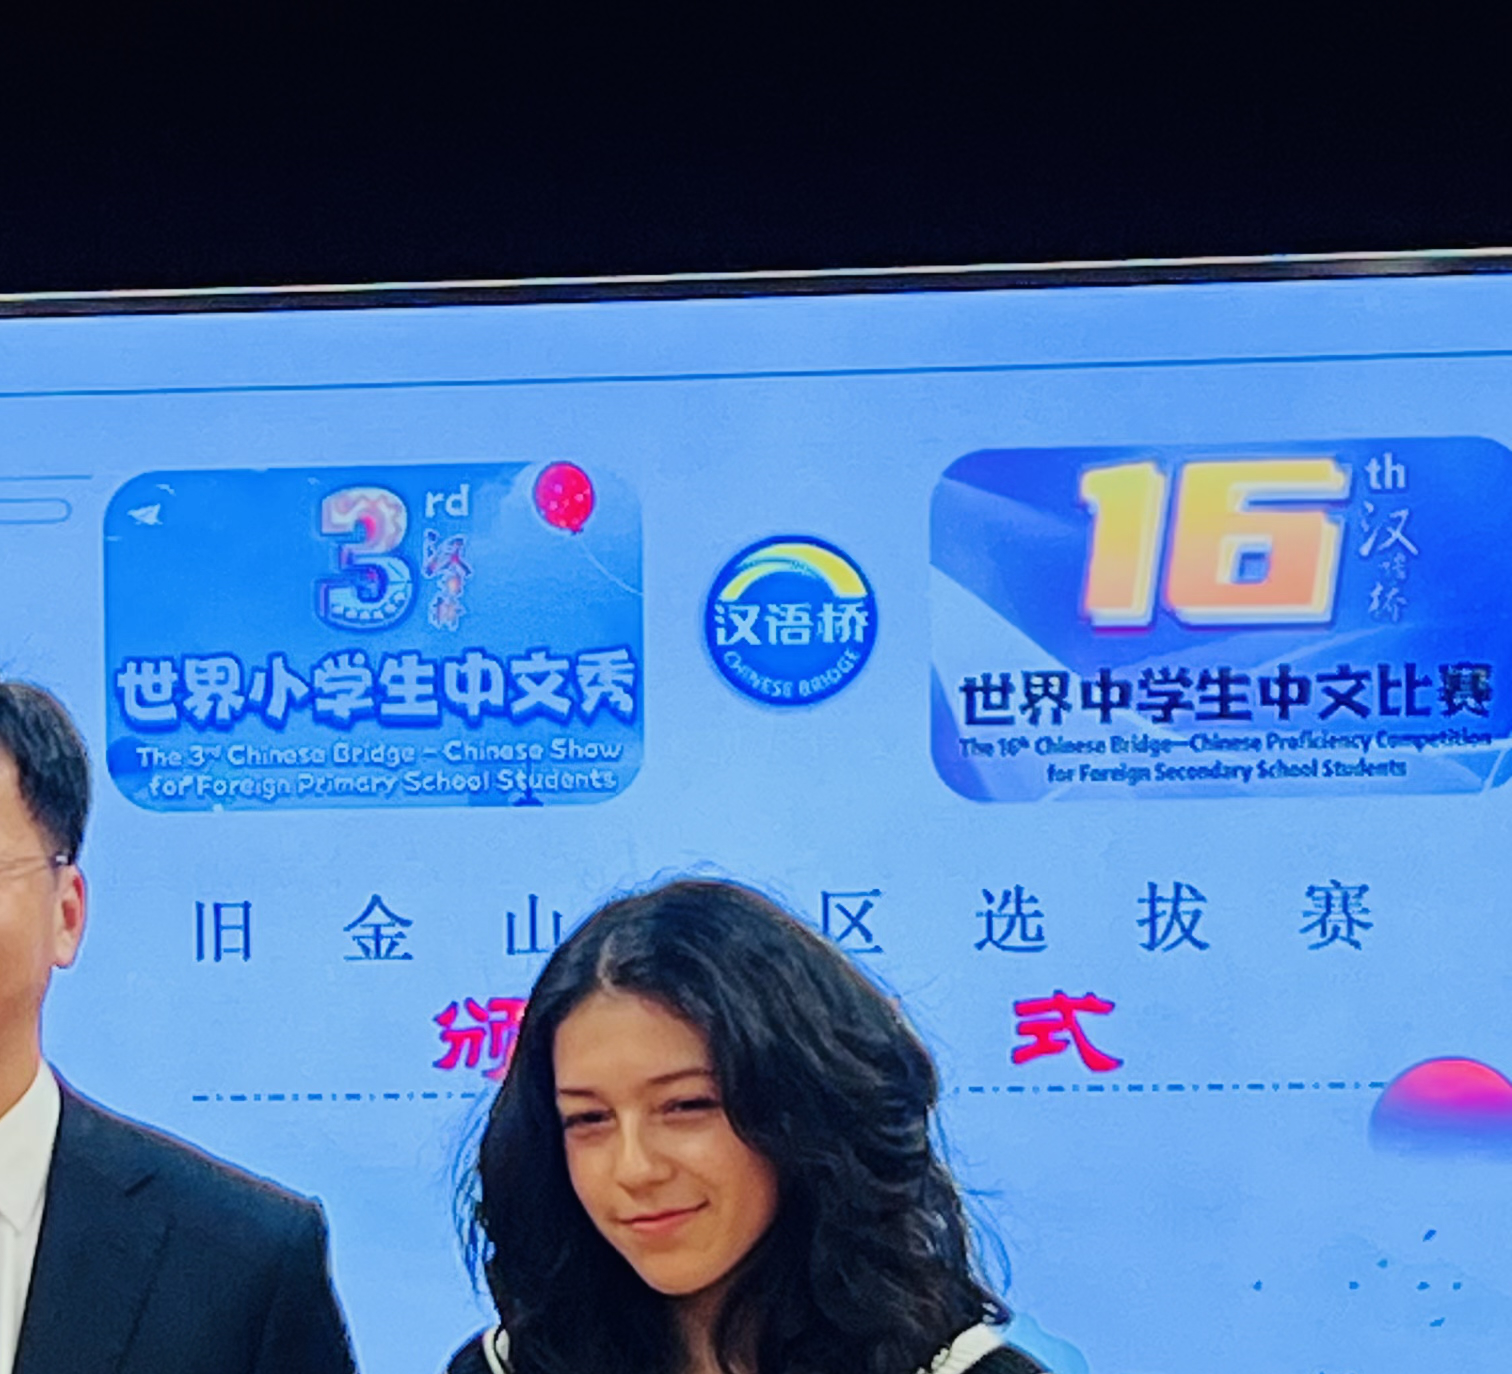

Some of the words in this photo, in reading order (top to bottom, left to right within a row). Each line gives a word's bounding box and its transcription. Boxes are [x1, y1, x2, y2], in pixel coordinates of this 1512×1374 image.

[713, 602, 870, 646] 汉语桥
[116, 647, 636, 723] 世界小学生中文秀
[723, 650, 793, 698] CHINESE
[798, 648, 862, 697] BRIDGE
[958, 661, 1493, 726] 世界中学生中文比赛
[136, 746, 182, 767] The
[226, 743, 325, 766] Chinese
[333, 741, 415, 767] Bridge
[442, 739, 544, 761] Chinese
[550, 737, 623, 760] Show
[959, 737, 994, 757] The
[1034, 735, 1106, 756] Chinese
[1265, 729, 1372, 753] Proficiency
[1376, 726, 1493, 752] Competition
[149, 774, 194, 797] for
[196, 774, 294, 800] Foreign
[297, 772, 399, 794] Primary
[402, 769, 489, 792] School
[496, 768, 617, 791] Students
[1047, 763, 1075, 782] for
[1079, 762, 1151, 786] Foreign
[1154, 759, 1254, 783] Secondary
[1256, 758, 1318, 779] School
[1322, 757, 1407, 777] Students
[195, 878, 1374, 962] 旧金山区选拔赛
